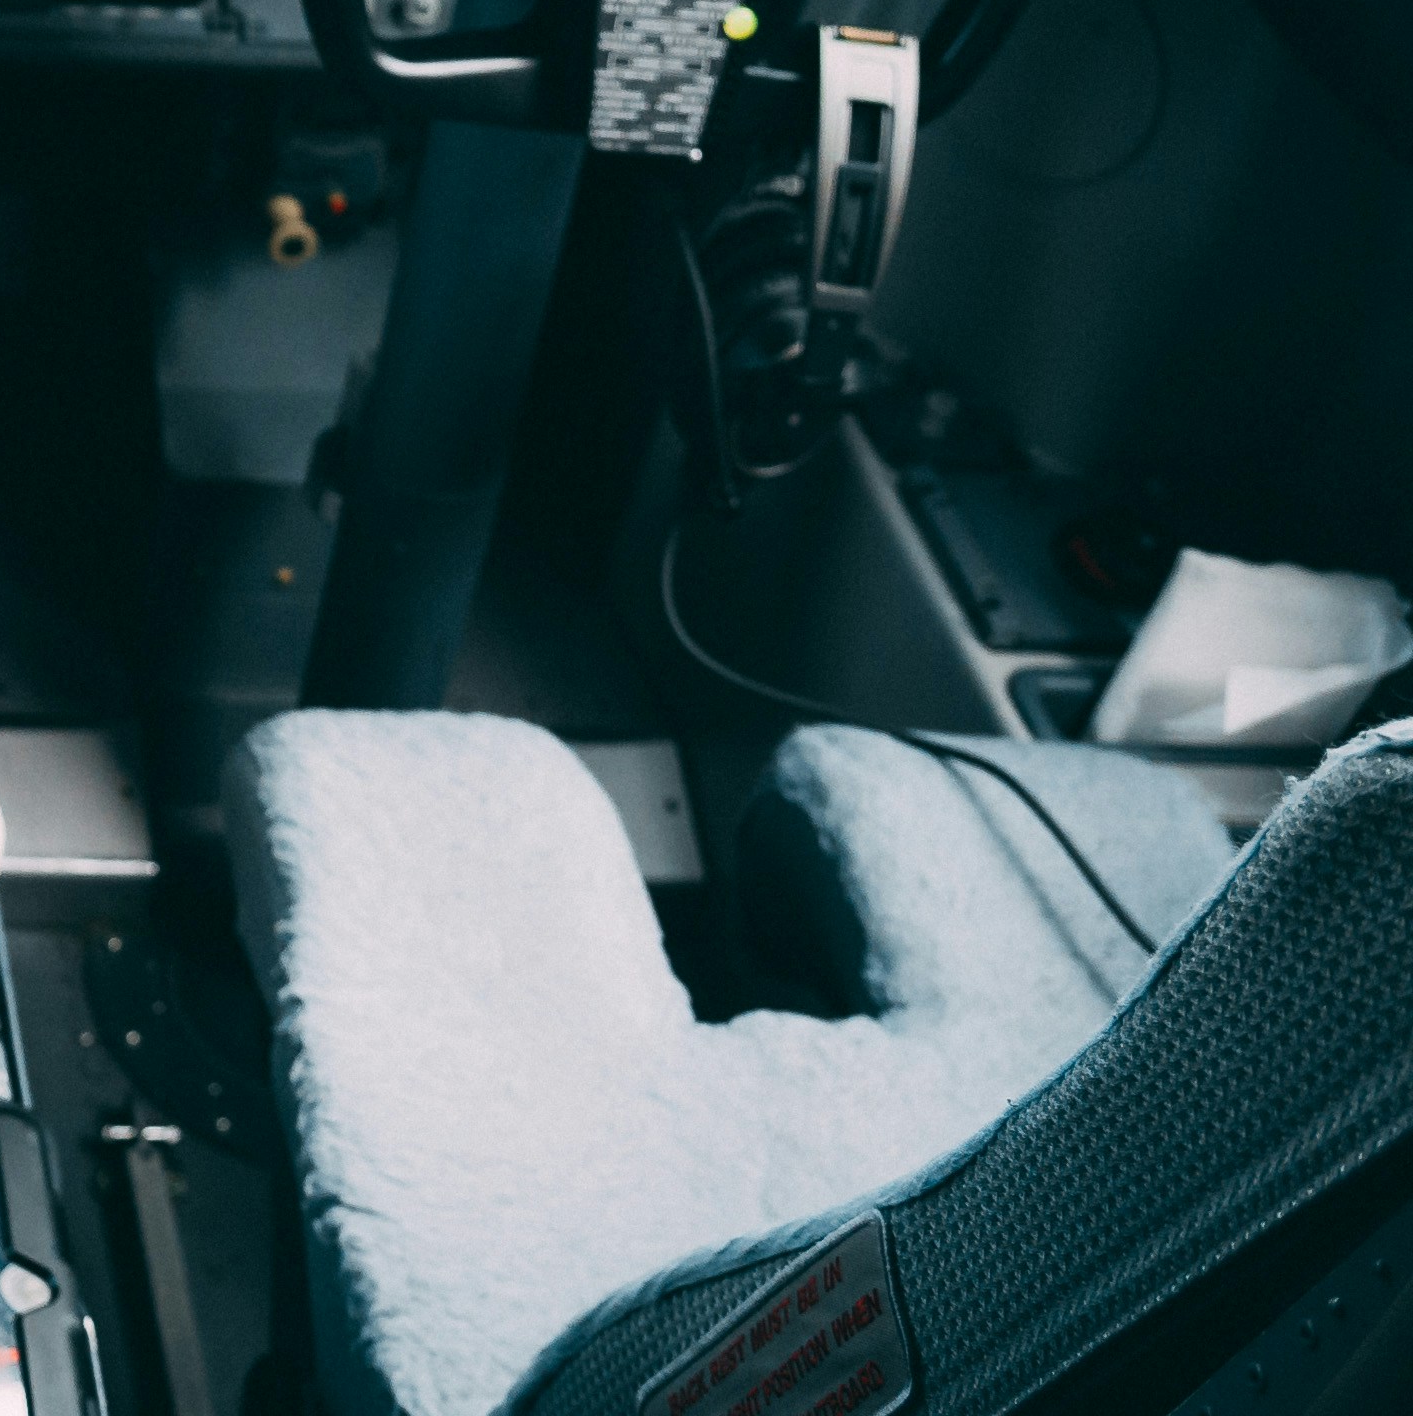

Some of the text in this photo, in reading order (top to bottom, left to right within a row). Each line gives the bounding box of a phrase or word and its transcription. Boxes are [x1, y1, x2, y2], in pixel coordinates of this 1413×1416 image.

[708, 1334, 746, 1385] REST
[749, 1296, 791, 1354] MUST
[796, 1274, 820, 1315] BE
[823, 1256, 843, 1293] IN
[761, 1328, 831, 1407] POSITION
[830, 1287, 883, 1348] WHEN
